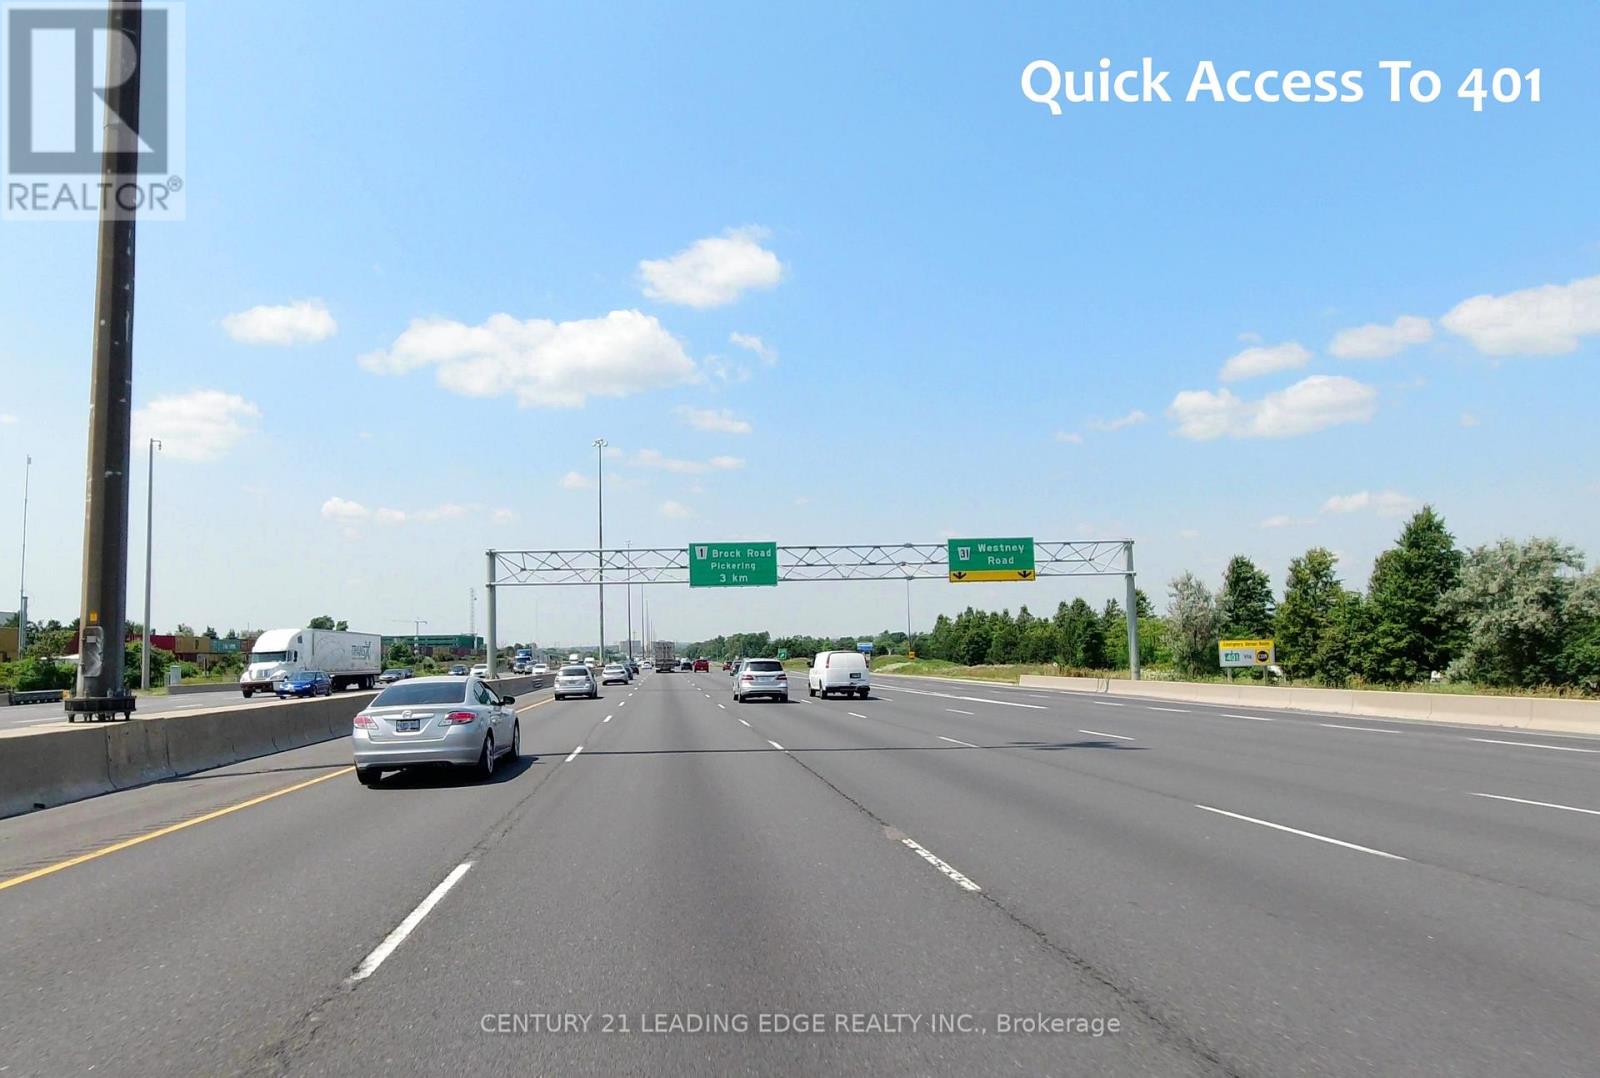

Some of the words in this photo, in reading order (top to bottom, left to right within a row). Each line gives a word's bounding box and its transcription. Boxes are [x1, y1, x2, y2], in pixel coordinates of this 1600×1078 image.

[712, 549, 741, 558] Brock
[747, 548, 772, 558] Road
[977, 543, 1025, 553] Westney
[960, 549, 969, 559] 31
[988, 556, 1014, 565] Road
[710, 562, 756, 571] Pickering
[719, 574, 727, 583] 3
[732, 573, 748, 583] km
